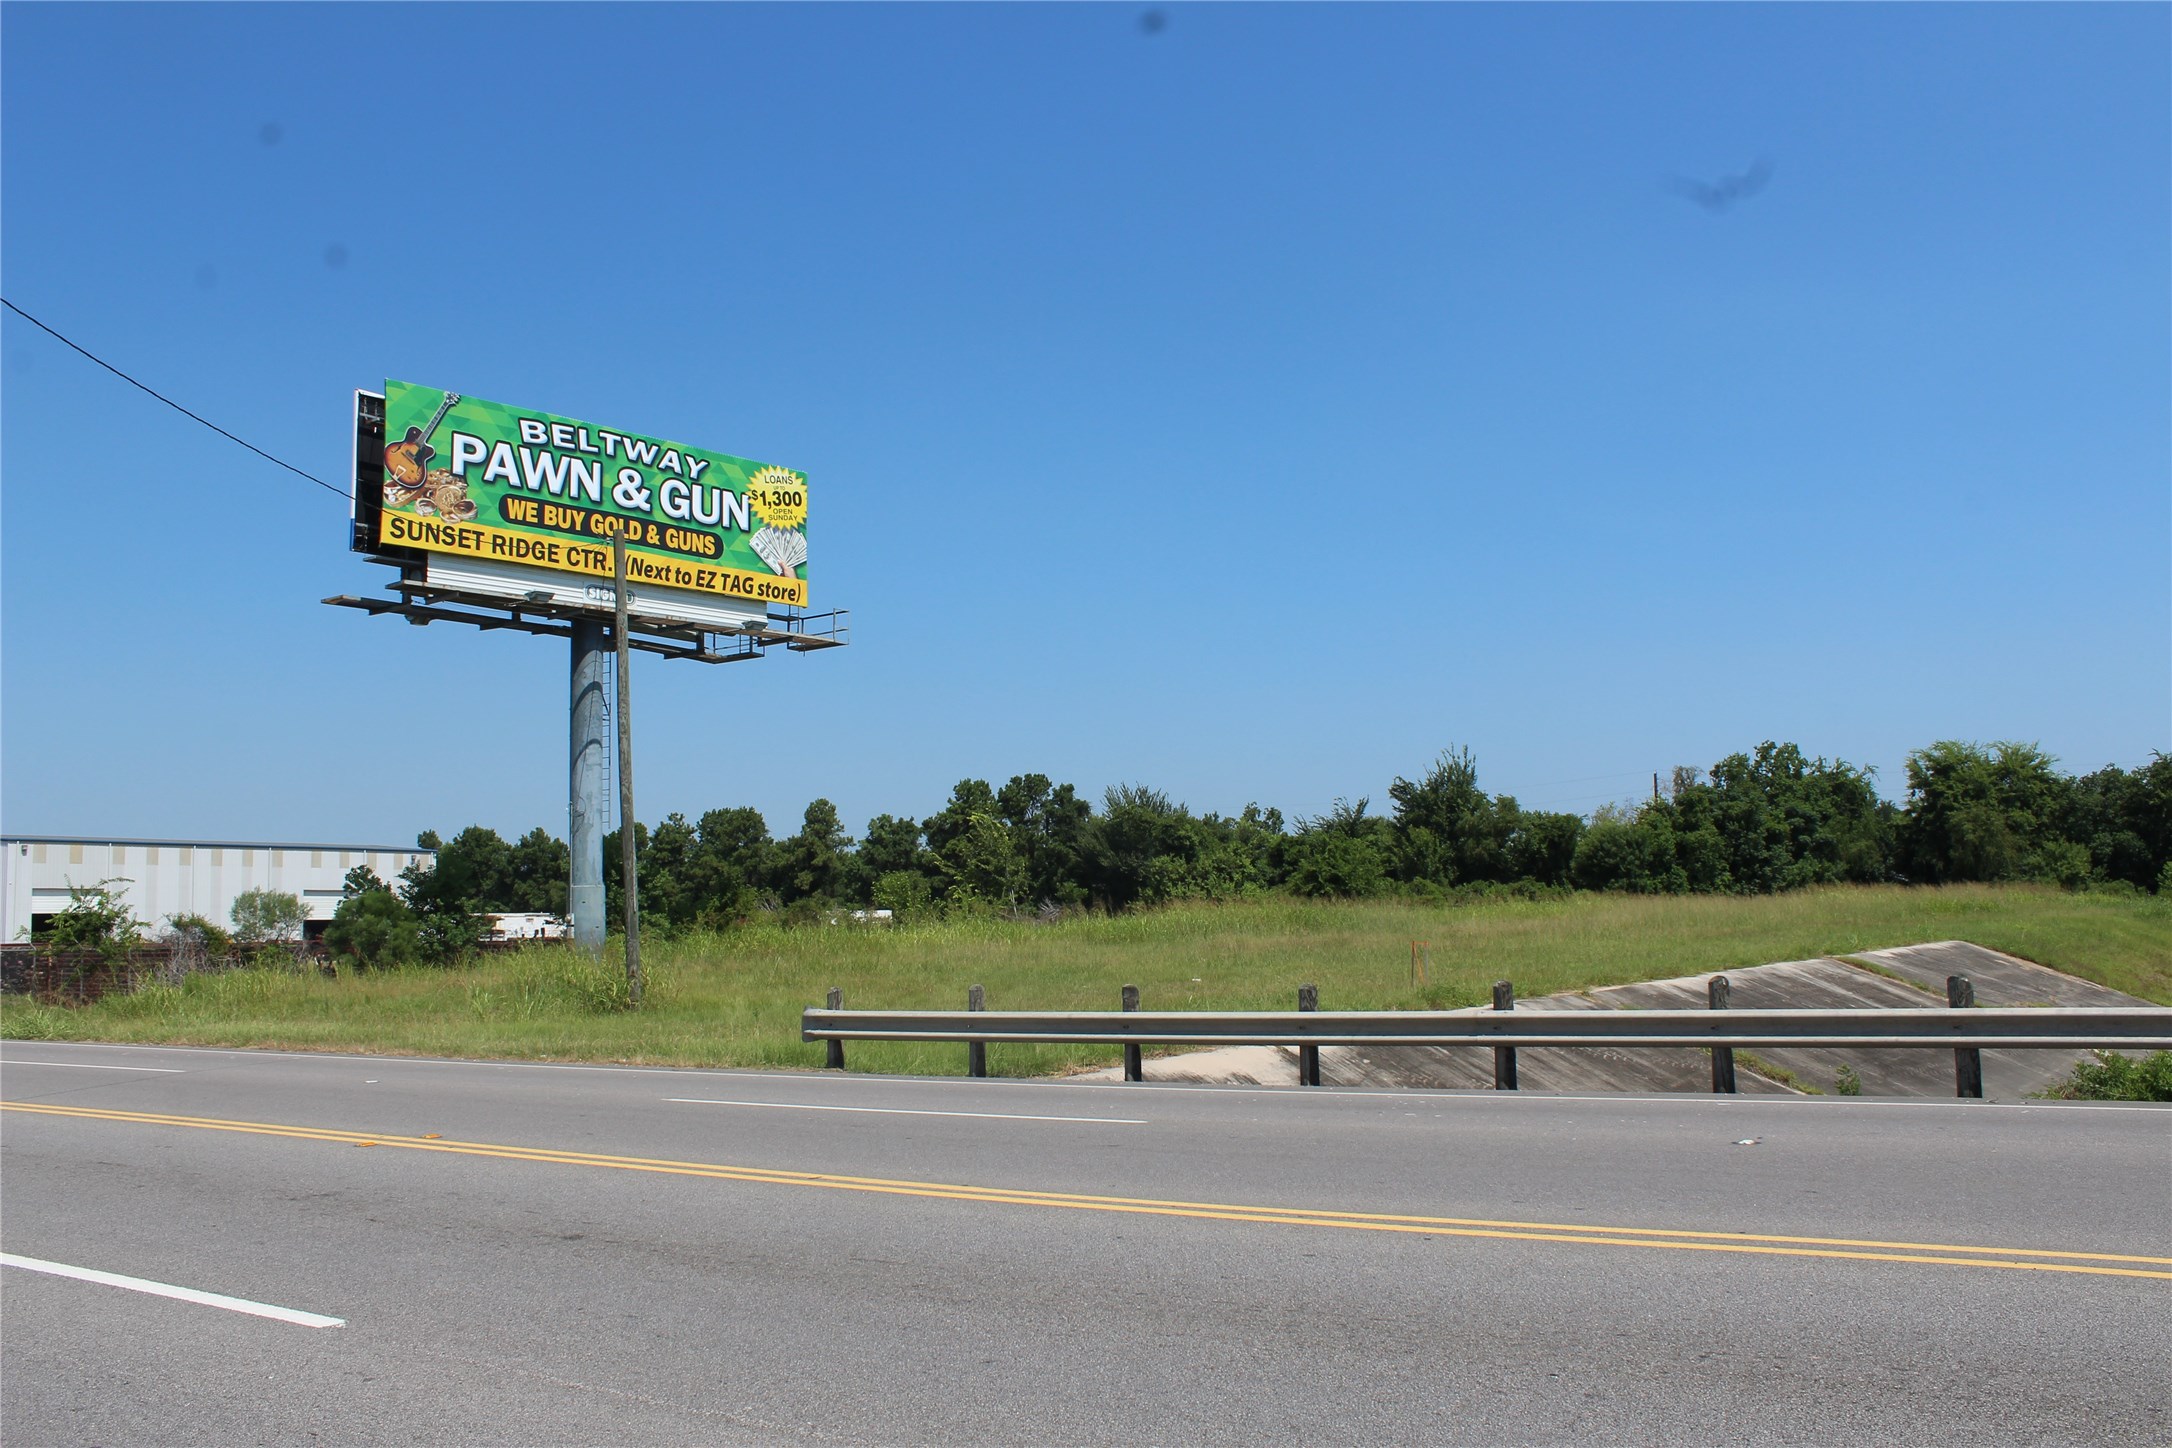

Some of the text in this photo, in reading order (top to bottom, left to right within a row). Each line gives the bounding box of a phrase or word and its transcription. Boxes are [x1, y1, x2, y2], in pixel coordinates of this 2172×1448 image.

[519, 419, 709, 480] BELTWAY
[453, 432, 749, 531] PAWN & GUN
[751, 490, 803, 510] $1,300
[764, 475, 794, 485] LOANS
[507, 498, 716, 556] WE BUY GOLD & GUNS
[390, 518, 801, 602] SUNSET RIDGE CTR. (Next to EZ TAG store)
